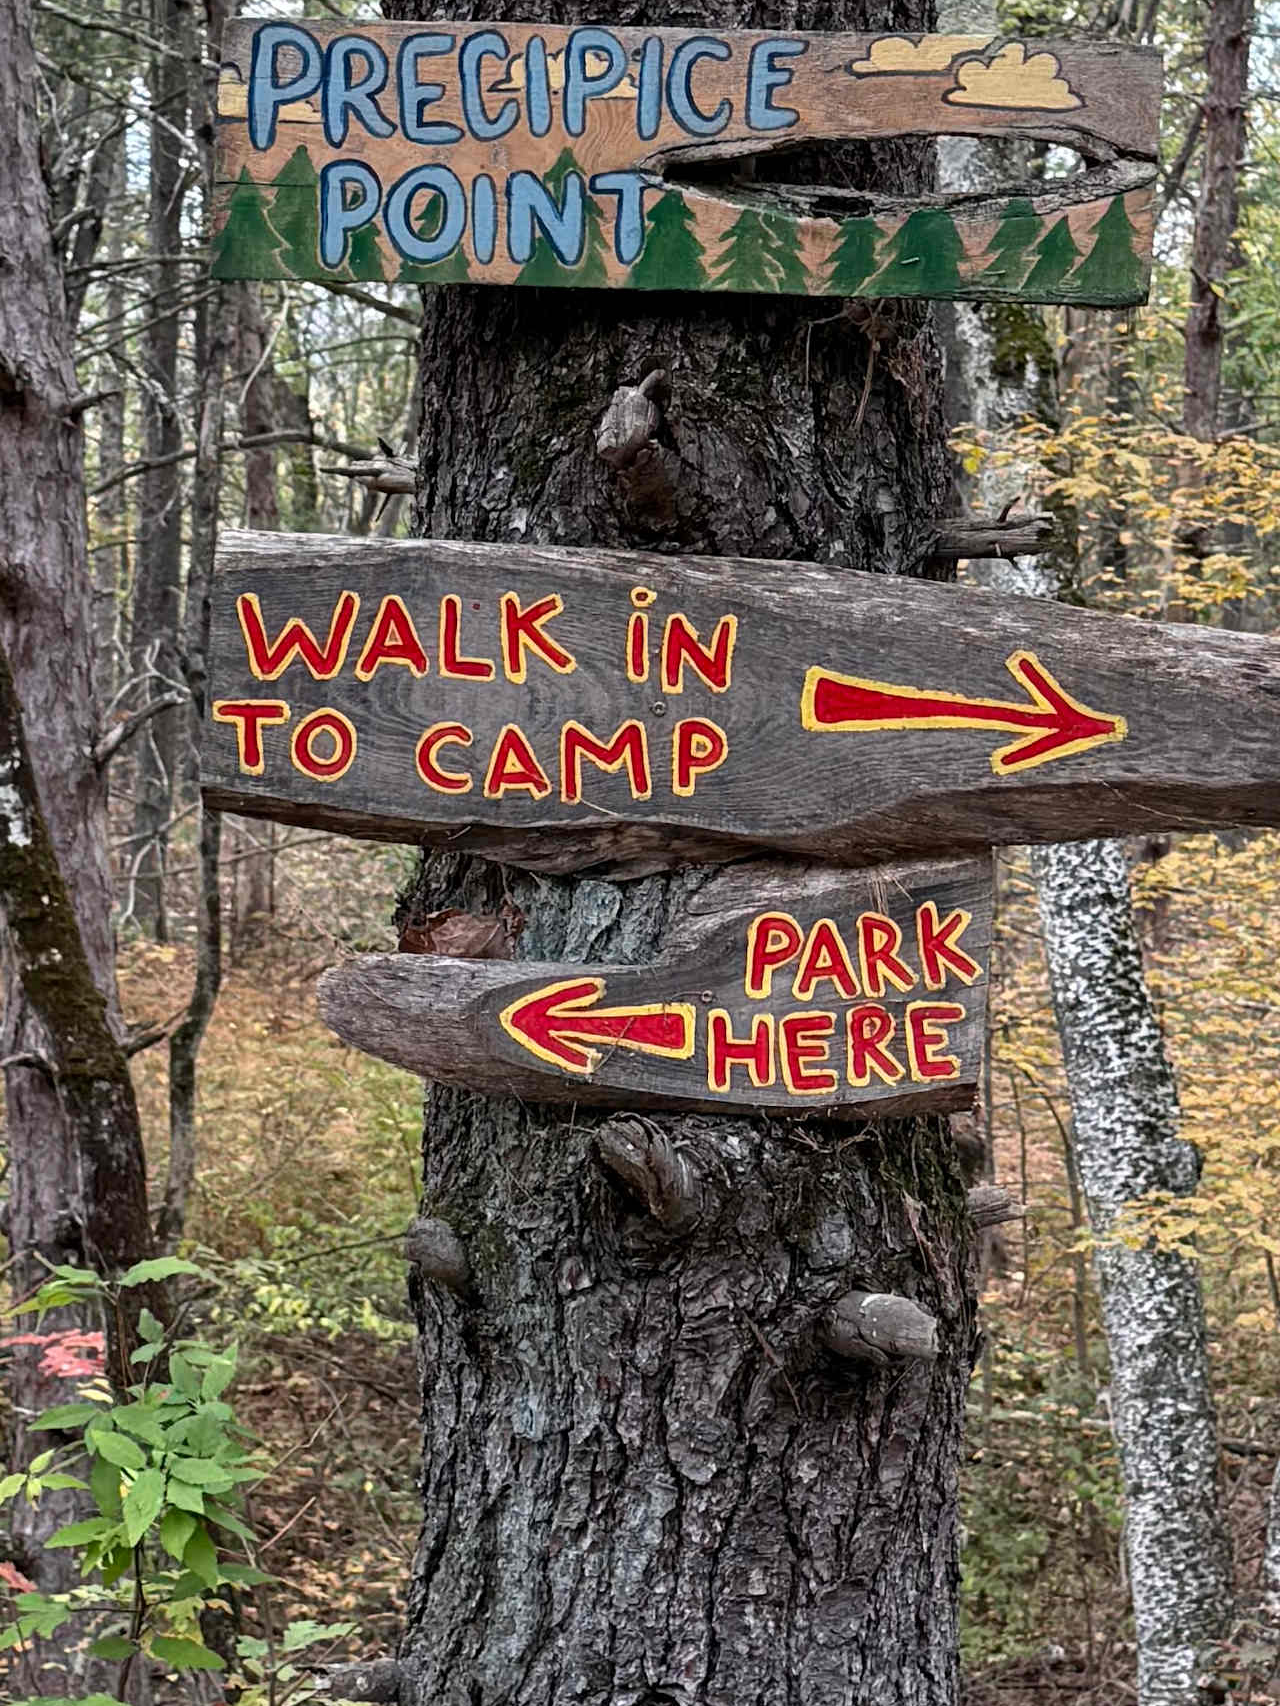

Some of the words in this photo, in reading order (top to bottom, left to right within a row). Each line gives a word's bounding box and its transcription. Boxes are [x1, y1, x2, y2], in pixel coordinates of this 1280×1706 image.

[249, 22, 809, 151] PRECIPICE
[320, 158, 658, 268] POINT
[236, 590, 577, 684] WALK
[213, 698, 357, 783] TO
[415, 717, 728, 805] CAMP
[744, 900, 984, 1001] PARK
[707, 1002, 967, 1095] HERE
